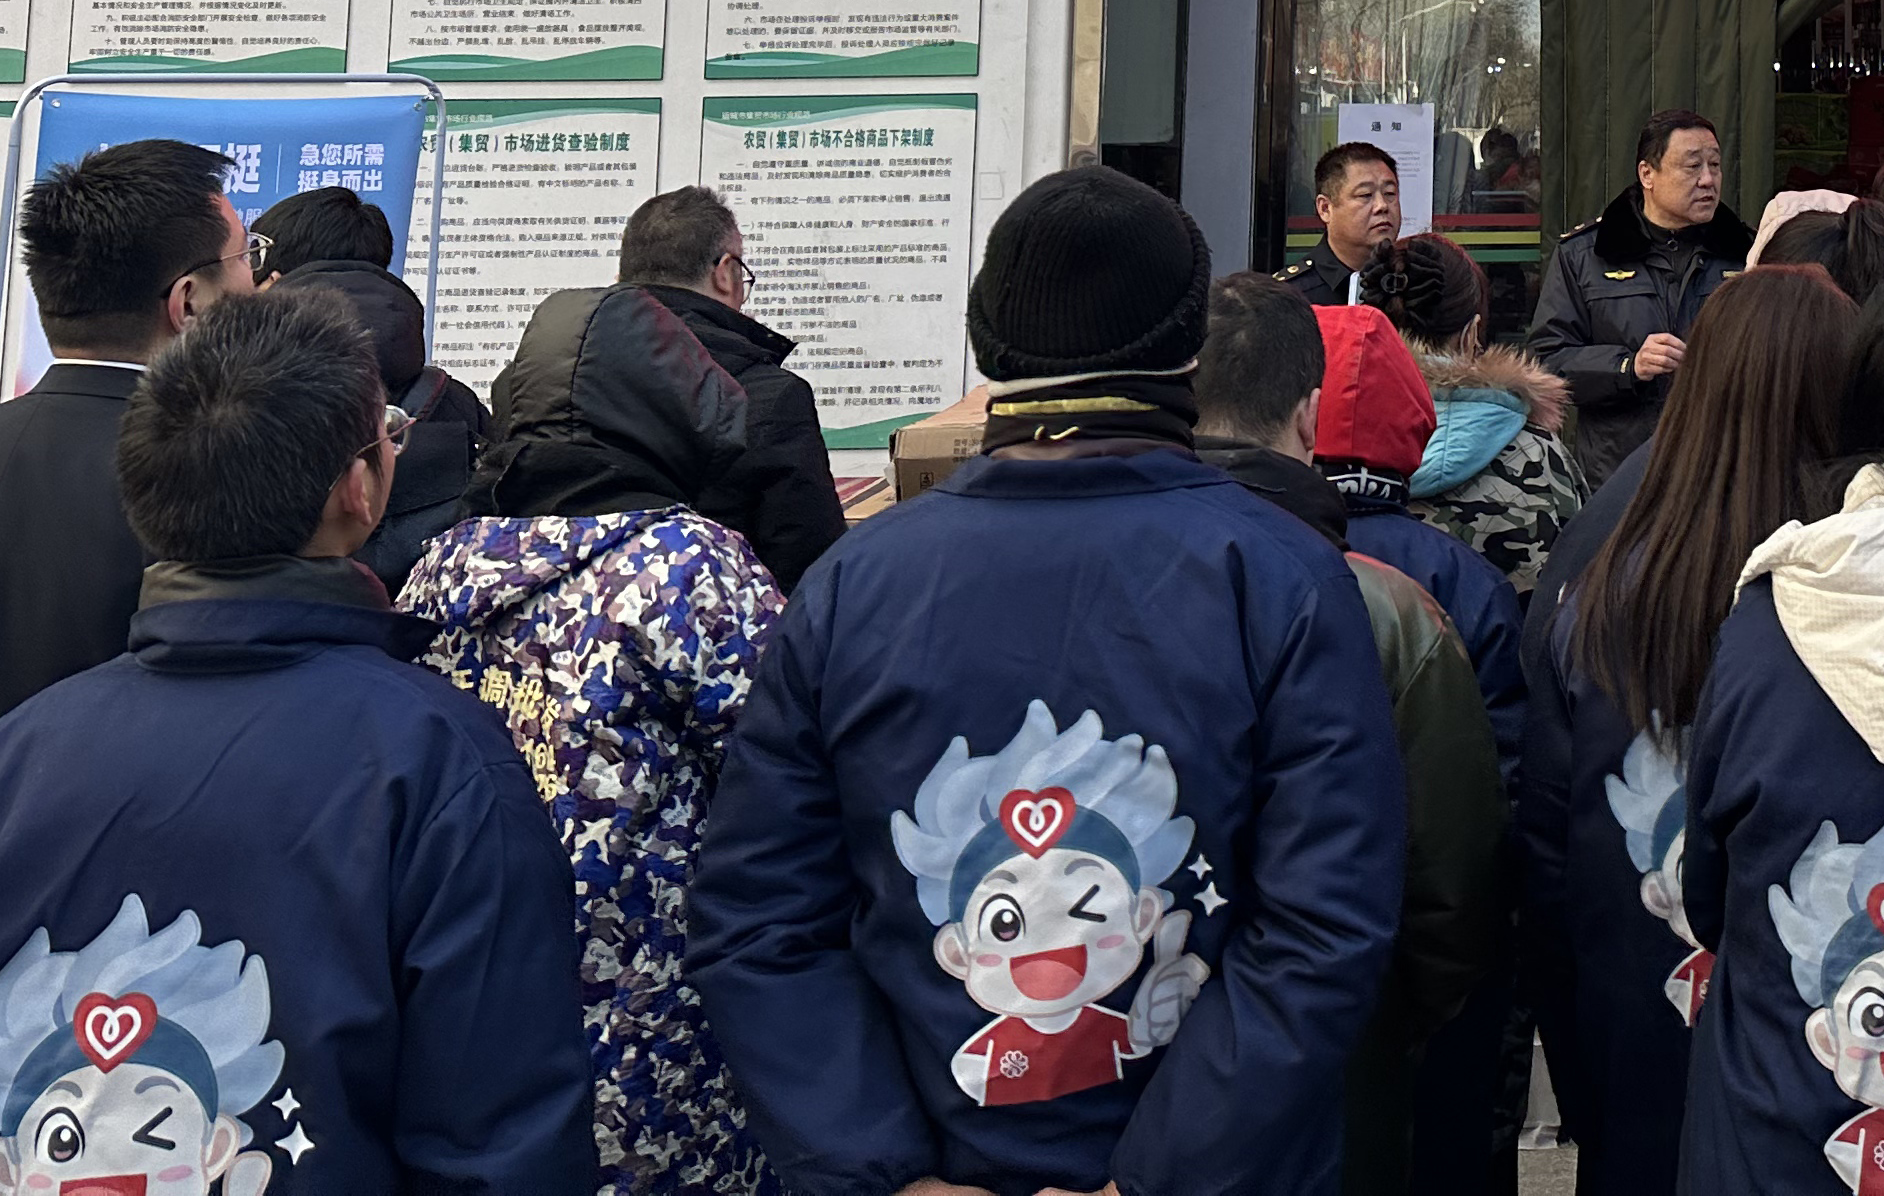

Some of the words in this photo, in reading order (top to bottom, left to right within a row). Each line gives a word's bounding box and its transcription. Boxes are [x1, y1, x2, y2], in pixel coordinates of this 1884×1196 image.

[1371, 121, 1402, 133] 通知
[299, 143, 385, 167] 急您所需
[297, 169, 384, 193] 挺身而出
